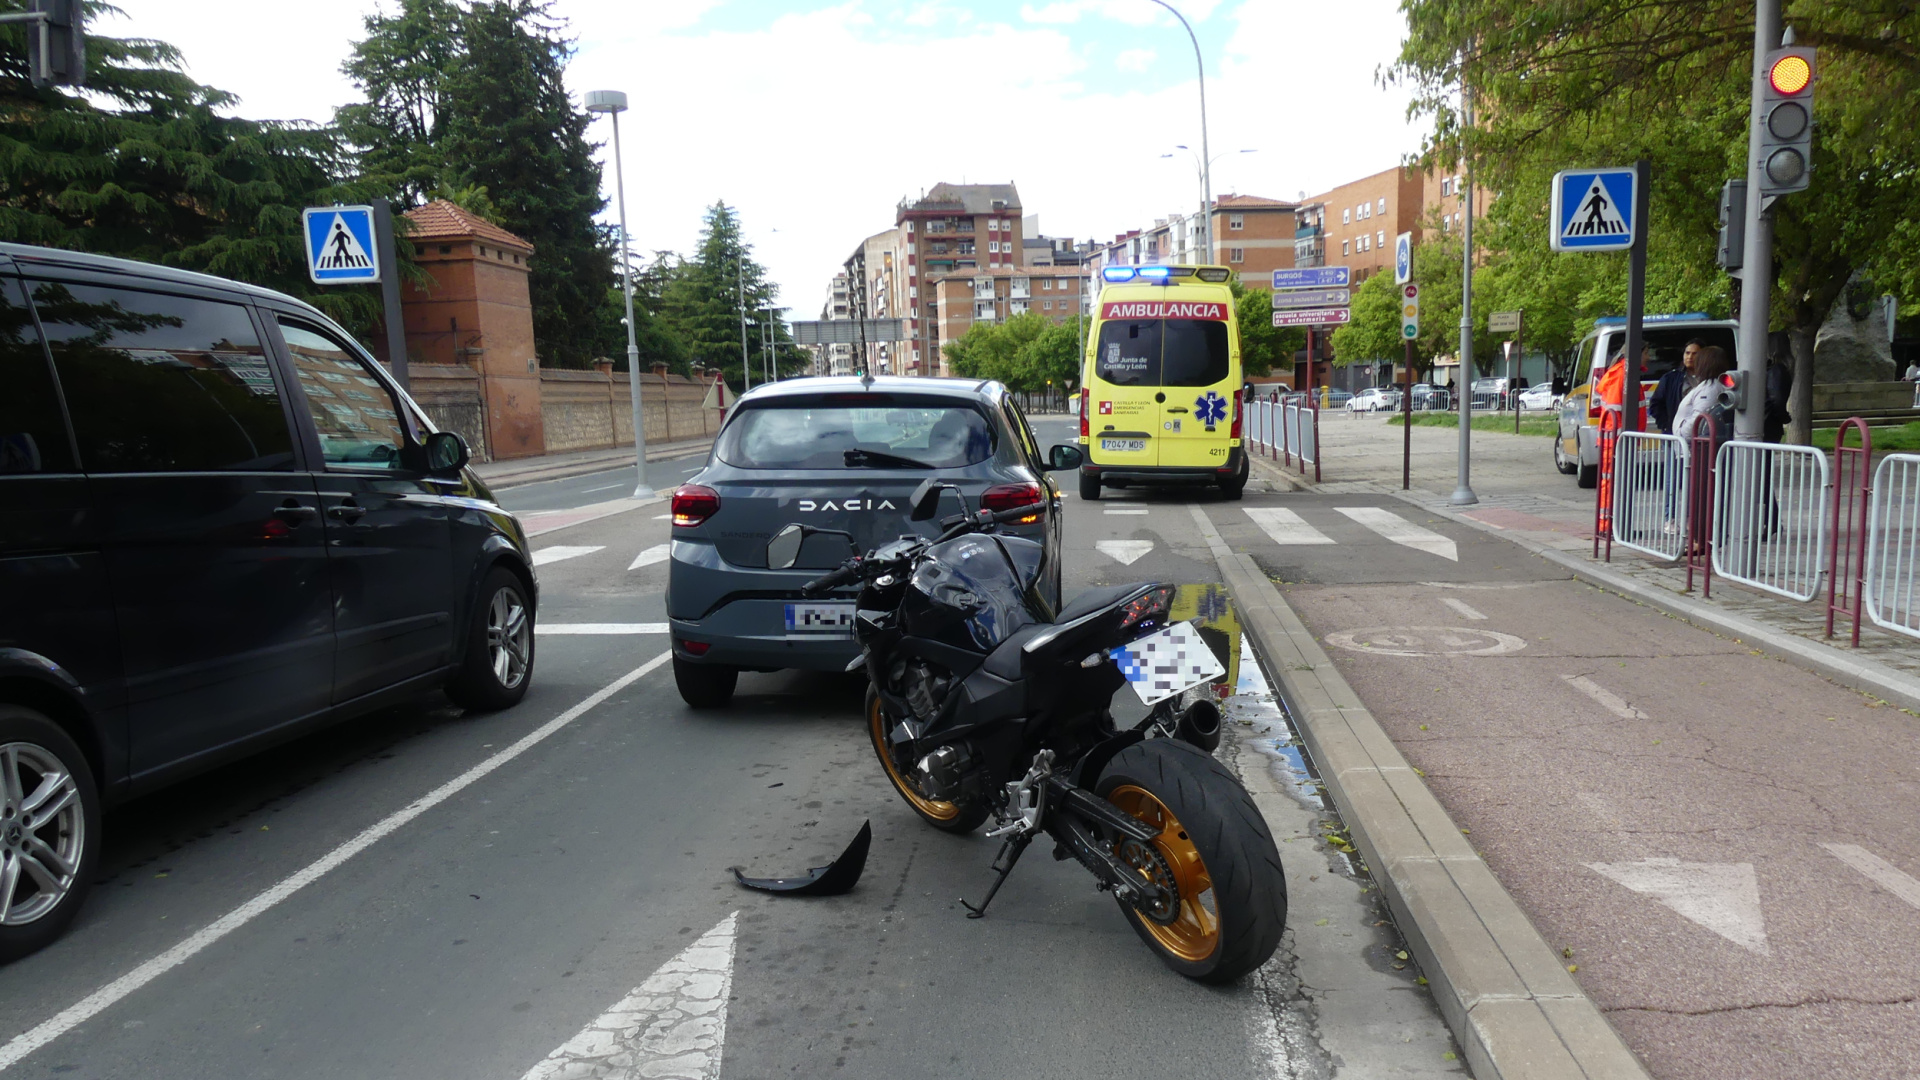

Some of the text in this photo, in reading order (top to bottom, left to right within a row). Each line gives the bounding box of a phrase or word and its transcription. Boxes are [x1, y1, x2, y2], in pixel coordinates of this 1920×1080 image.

[1276, 272, 1303, 280] BURGOS
[1293, 295, 1323, 303] industrial
[1108, 303, 1220, 317] AMBULANCIA
[1298, 310, 1335, 318] universitaria
[1106, 440, 1144, 449] 7047 MDS
[1209, 448, 1225, 456] 4211
[799, 499, 896, 511] DACIA
[720, 531, 771, 540] SANDERO
